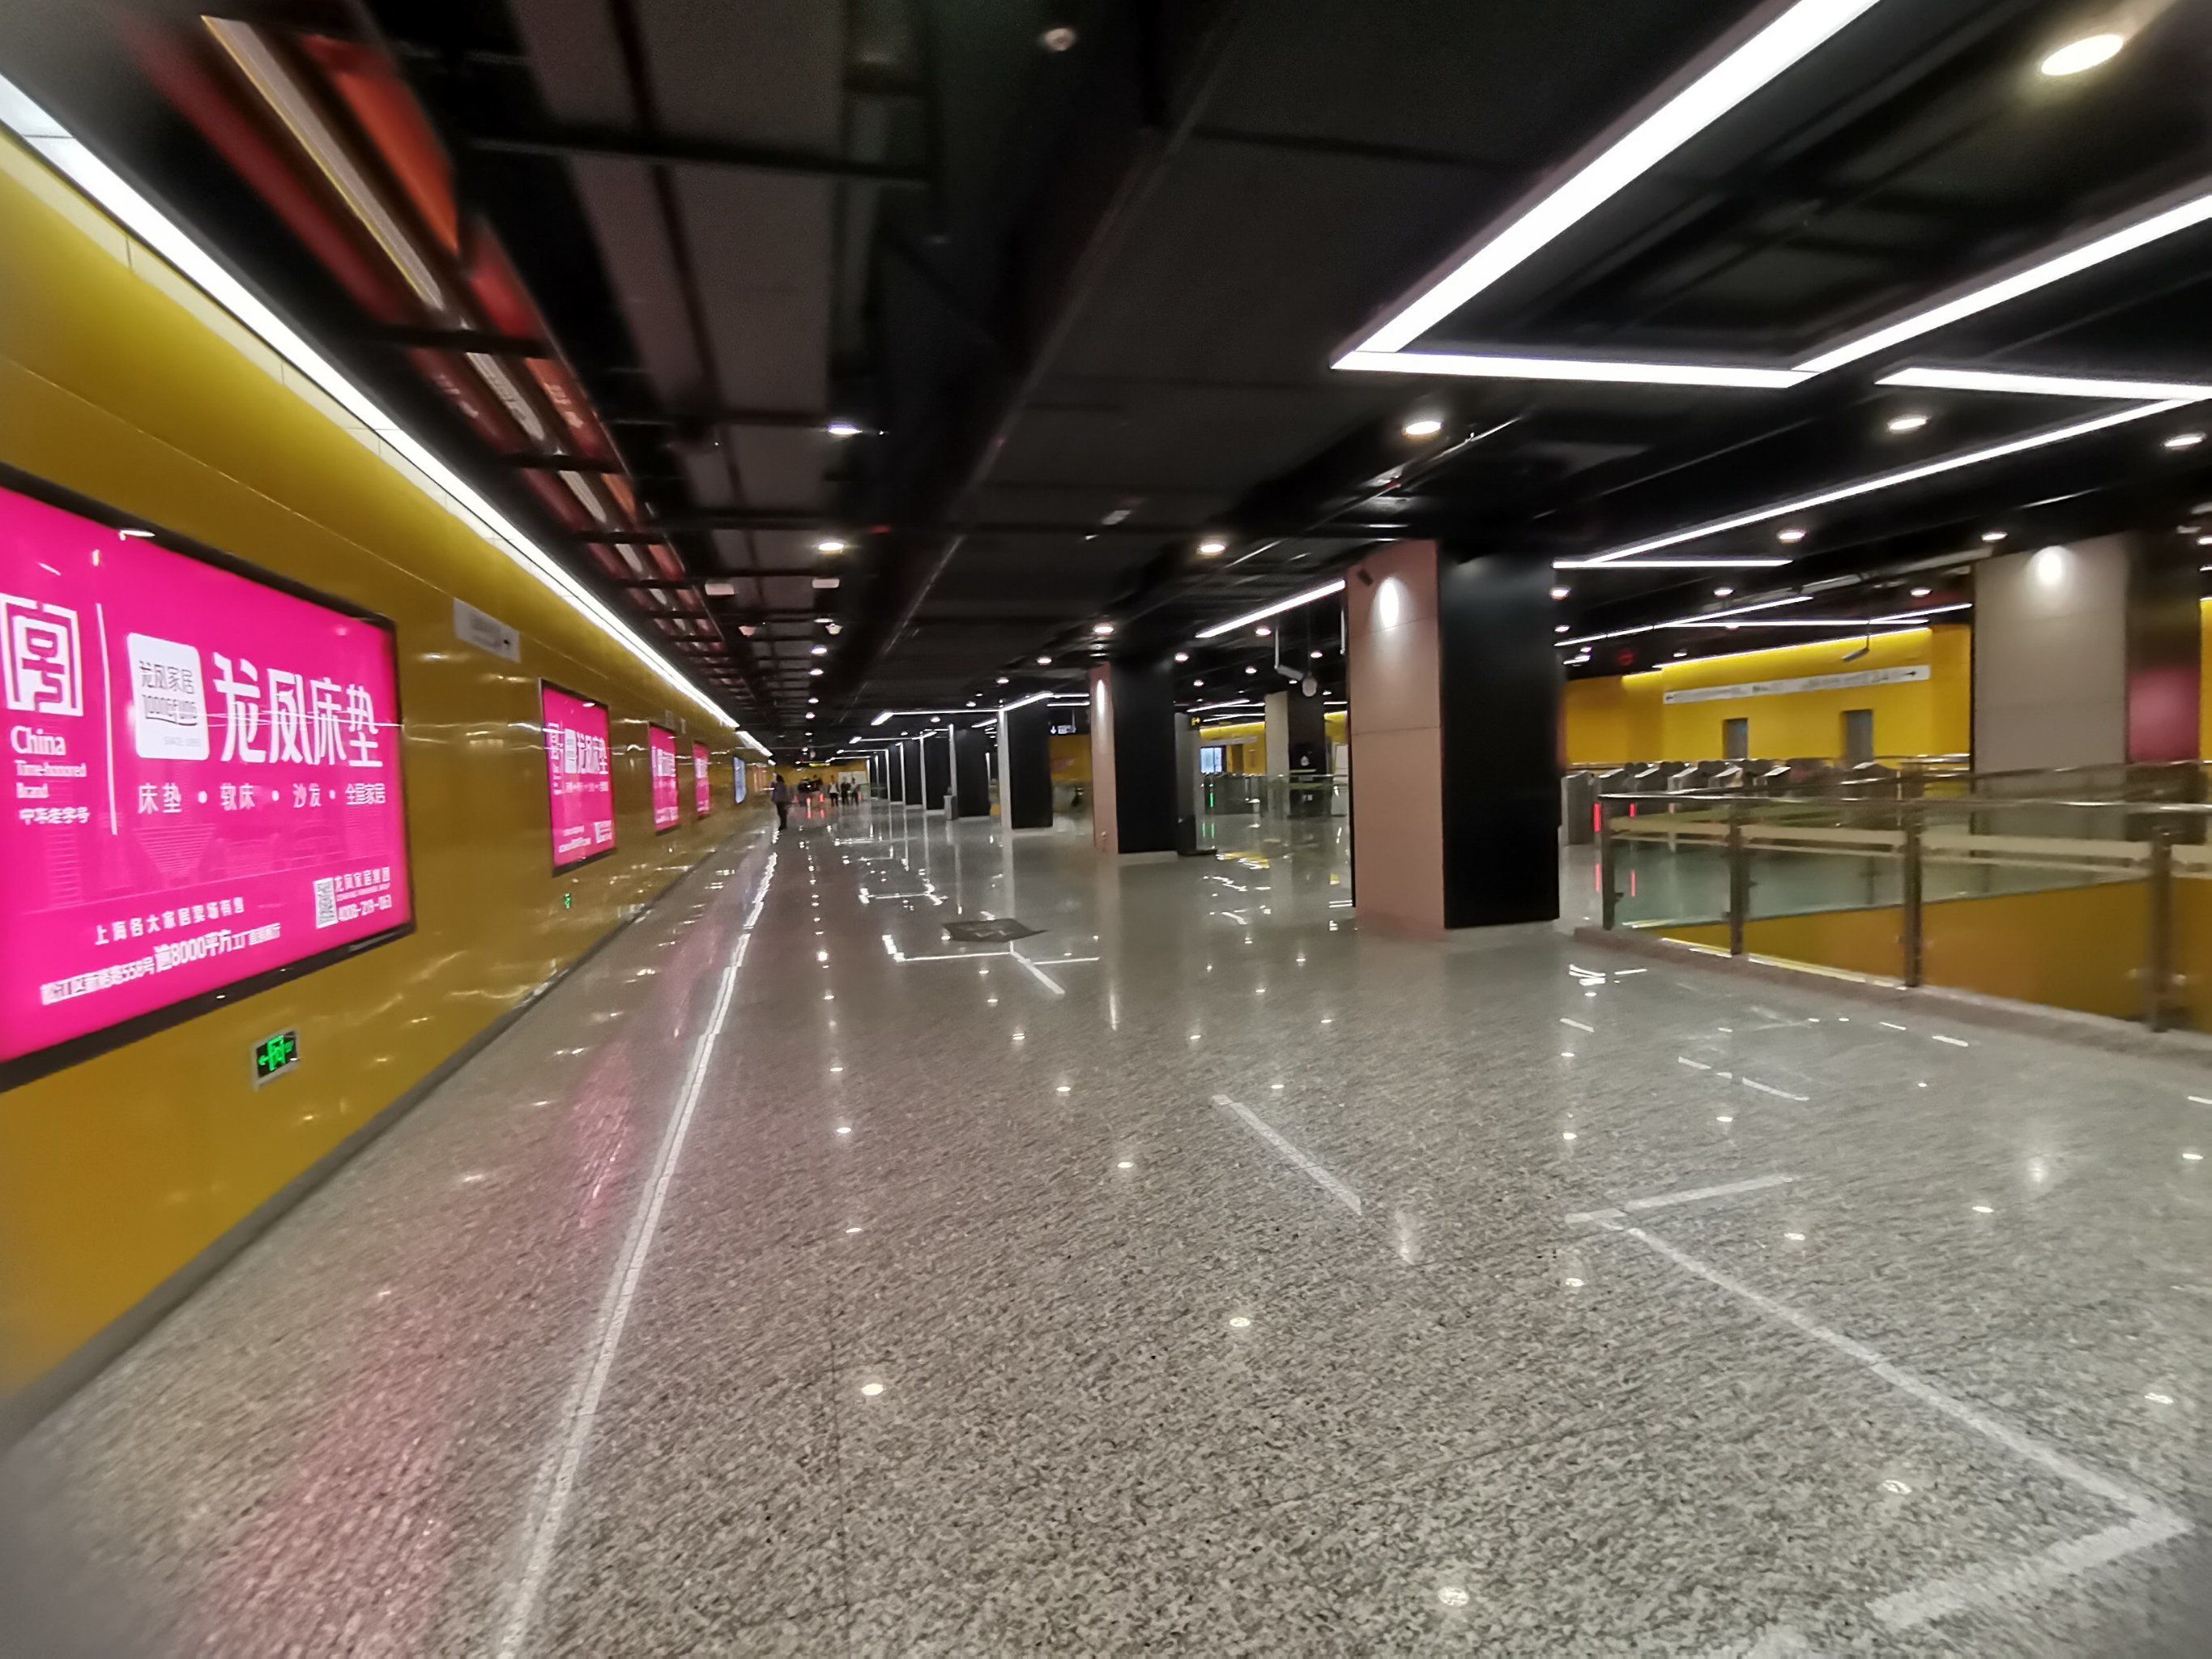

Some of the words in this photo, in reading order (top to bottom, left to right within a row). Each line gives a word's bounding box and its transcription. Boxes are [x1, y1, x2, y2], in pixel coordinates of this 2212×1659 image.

[11, 726, 66, 756] China
[212, 651, 383, 767] 龙凤床垫
